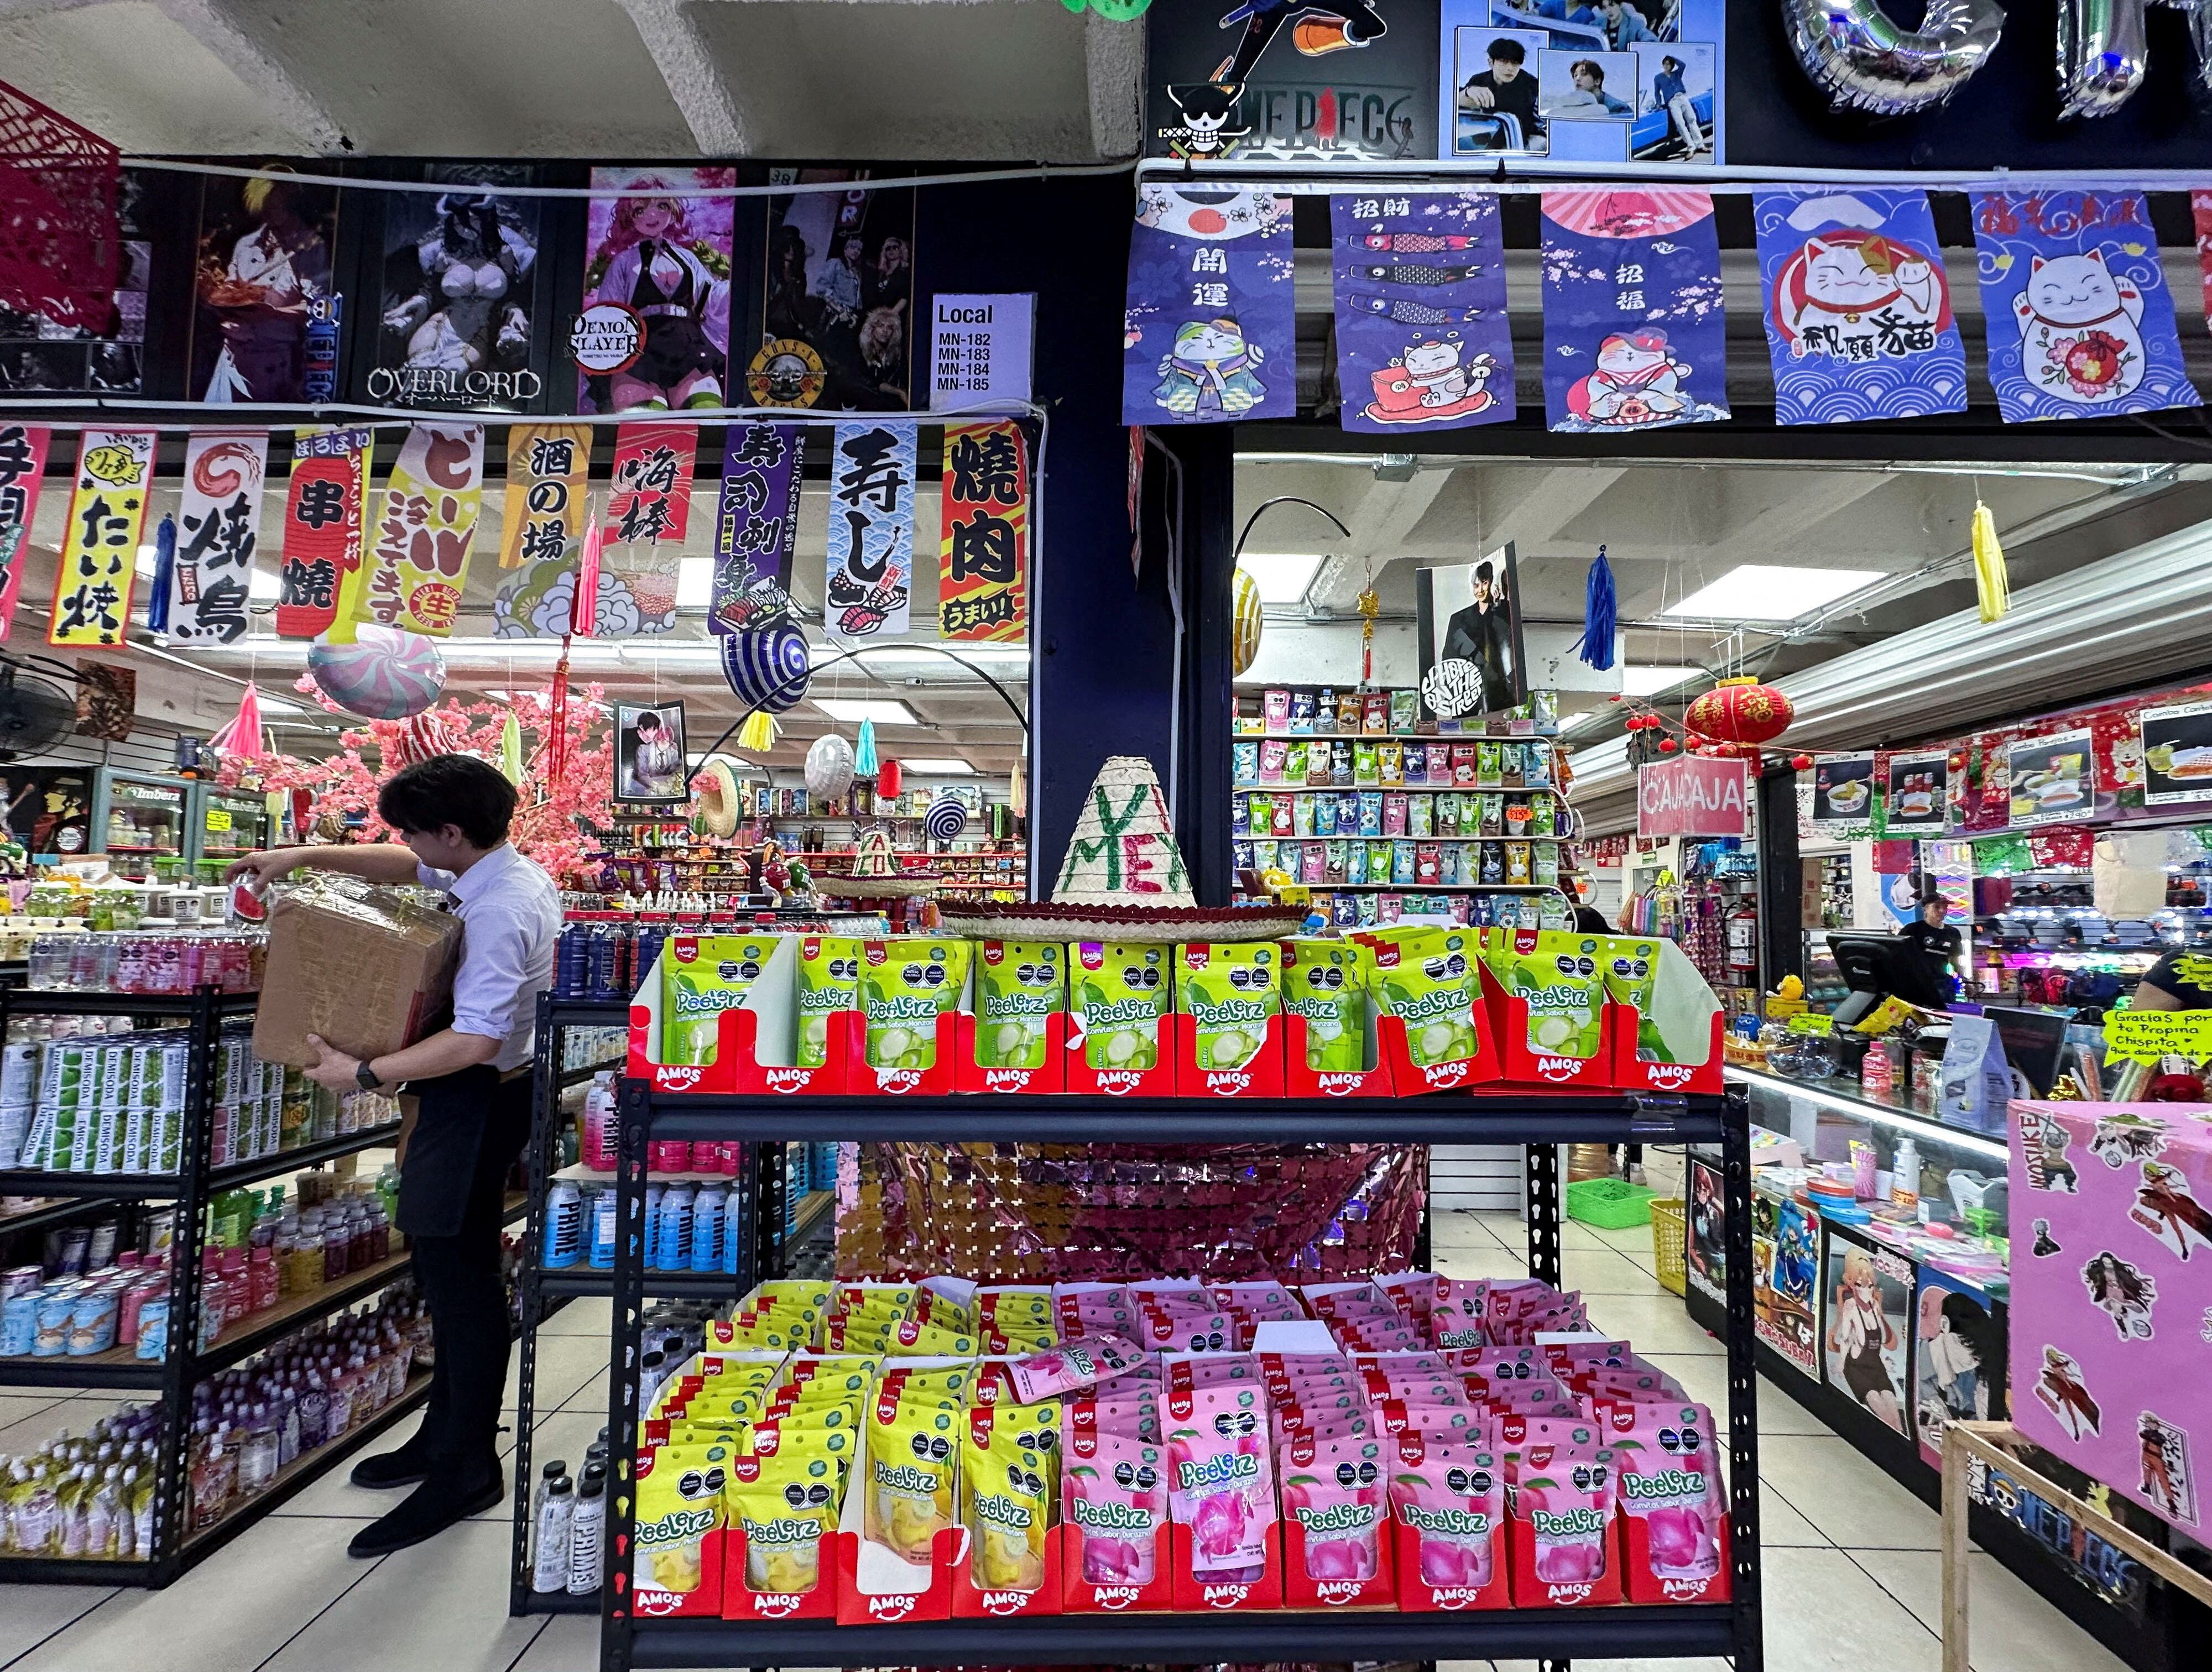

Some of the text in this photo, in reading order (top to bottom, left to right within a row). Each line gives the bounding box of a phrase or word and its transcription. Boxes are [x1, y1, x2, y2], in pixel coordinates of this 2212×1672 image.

[1352, 198, 1410, 218] 招財
[1192, 248, 1229, 306] 開運
[1615, 263, 1645, 310] 招福
[938, 305, 993, 324] Local
[568, 314, 639, 335] DEMON
[564, 334, 644, 358] SLAYER
[937, 333, 992, 347] MN-182
[937, 348, 990, 361] MN-183
[937, 363, 990, 376] MN-184
[367, 368, 541, 401] OVERLORD
[937, 377, 989, 391] MN-185
[295, 431, 371, 458] ほろよい
[521, 437, 575, 560] 酒の場
[837, 428, 907, 581] 寿し
[422, 594, 452, 617] 生
[948, 597, 1006, 628] うまい!
[1425, 666, 1483, 711] ON THE
[1436, 683, 1483, 718] STREET
[137, 787, 180, 802] Imbera
[1516, 937, 1536, 946] AMOS
[675, 945, 697, 956] AMOS
[985, 948, 1003, 957] AMOS
[1082, 952, 1102, 962] AMOS
[1187, 953, 1208, 962] AMOS
[1378, 952, 1398, 964] AMOS
[867, 996, 938, 1020] Peelerz
[985, 993, 1048, 1016] Peelerz
[1084, 998, 1156, 1023] Peelerz
[1189, 1000, 1265, 1023] Peelerz
[1392, 987, 1471, 1020] Peelerz
[2115, 1011, 2212, 1026] Gracias por
[1115, 1023, 1133, 1032] Sabor
[1220, 1025, 1240, 1033] Sabor
[2115, 1036, 2179, 1047] Chispita
[1425, 1062, 1468, 1084] AMOS
[1537, 1057, 1583, 1074] AMOS
[1647, 1064, 1693, 1080] AMOS
[81, 1050, 93, 1100] DEMISODA
[105, 1051, 117, 1100] DEMISODA
[131, 1051, 142, 1099] DEMISODA
[656, 1067, 701, 1084] AMOS
[766, 1070, 811, 1085] AMOS
[877, 1070, 921, 1086] AMOS
[985, 1070, 1030, 1085] AMOS
[1097, 1072, 1141, 1087] AMOS
[1206, 1073, 1251, 1088] AMOS
[1318, 1074, 1364, 1089] AMOS
[98, 1114, 112, 1164] DEMISODA
[125, 1114, 138, 1163] DEMISODA
[150, 1115, 161, 1164] DEMISODA
[554, 1201, 582, 1257] PRIME
[900, 1327, 918, 1339] AMOS
[1171, 1400, 1191, 1412] AMOS
[1614, 1413, 1634, 1424] AMOS
[1074, 1439, 1095, 1450] AMOS
[1292, 1448, 1313, 1458] AMOS
[874, 1460, 938, 1492] Peelerz
[1178, 1453, 1258, 1489] Peelerz
[1211, 1484, 1233, 1494] Sabor
[1623, 1469, 1705, 1499] Peelerz
[1073, 1497, 1152, 1529] Peelerz
[1296, 1503, 1375, 1533] Peelerz
[1403, 1503, 1488, 1535] Peelerz
[1532, 1507, 1604, 1536] Peelerz
[741, 1517, 822, 1544] Peelerz
[1100, 1529, 1120, 1539] Sabor
[1094, 1586, 1140, 1603] AMOS
[1204, 1585, 1248, 1601] AMOS
[1317, 1582, 1361, 1598] AMOS
[1548, 1583, 1593, 1599] AMOS
[1662, 1580, 1708, 1595] AMOS
[637, 1592, 684, 1608] AMOS
[754, 1593, 801, 1611] AMOS
[868, 1596, 916, 1613] AMOS
[982, 1592, 1028, 1609] AMOS
[1432, 1589, 1477, 1604] AMOS
